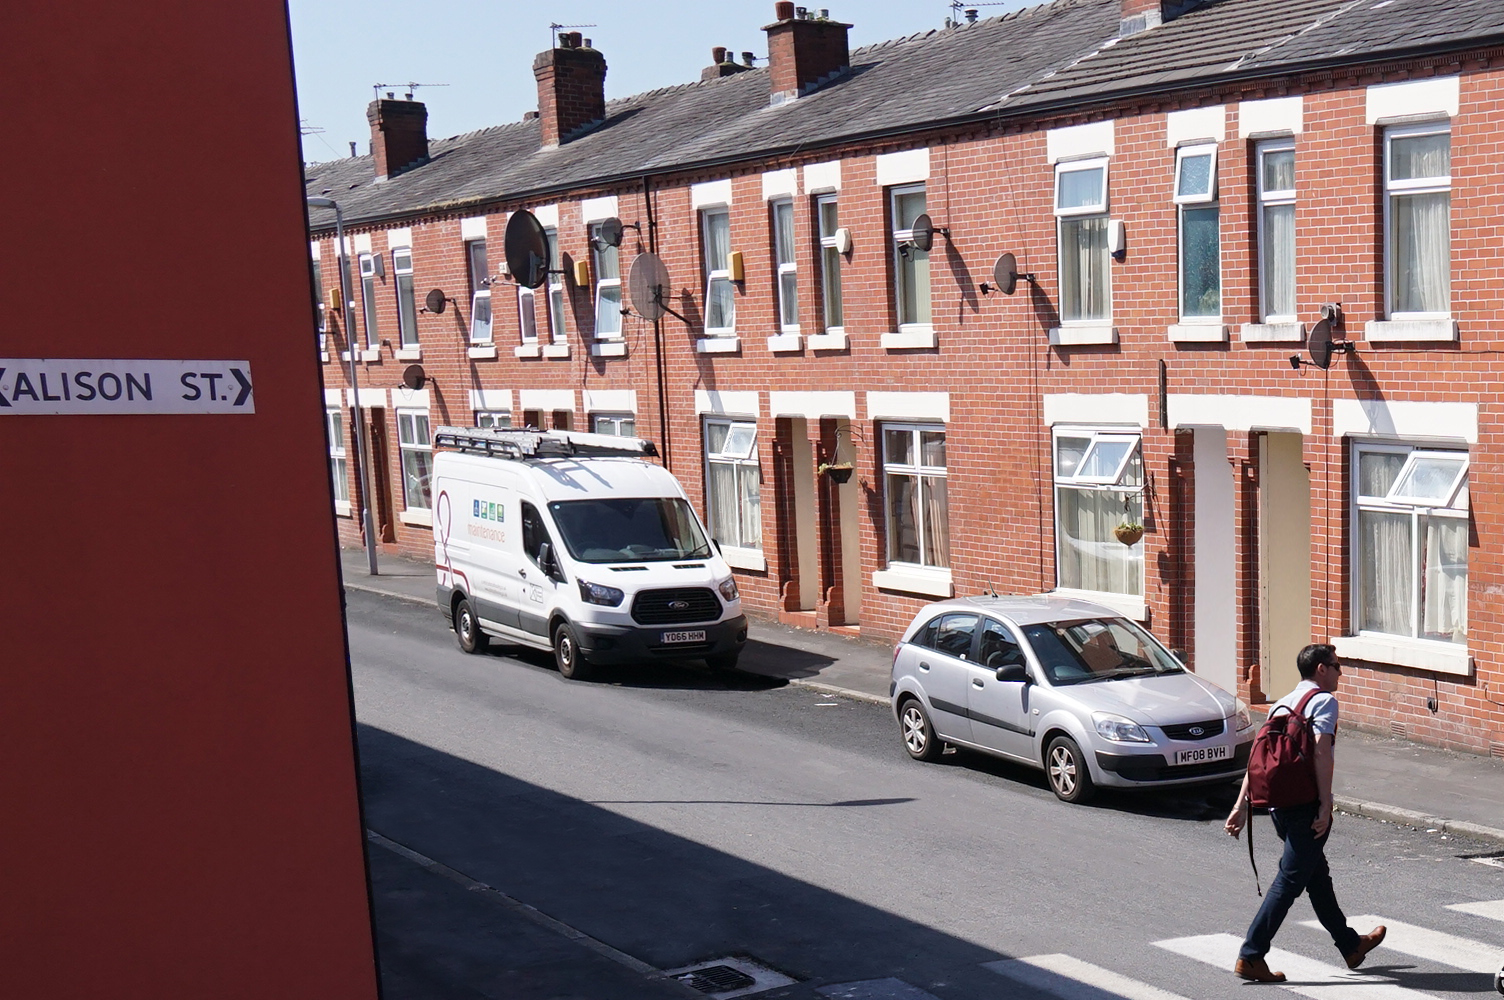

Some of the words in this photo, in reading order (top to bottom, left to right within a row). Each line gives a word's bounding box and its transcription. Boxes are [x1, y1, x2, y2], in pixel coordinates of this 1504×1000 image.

[12, 372, 153, 401] ALISON
[180, 372, 228, 401] ST.
[467, 523, 505, 543] maintenance
[1180, 750, 1205, 762] MF08
[1207, 746, 1226, 759] BVH
